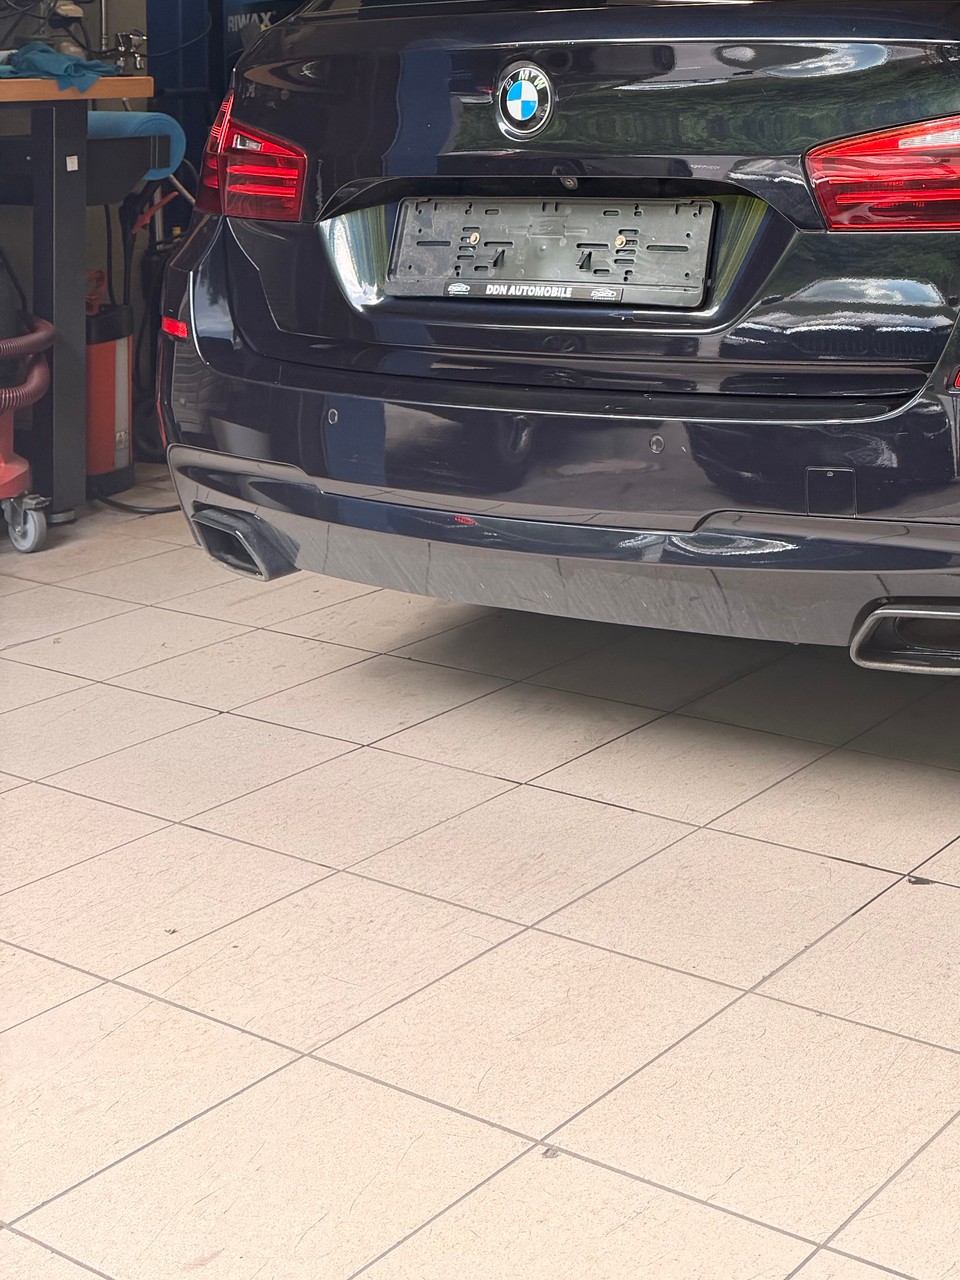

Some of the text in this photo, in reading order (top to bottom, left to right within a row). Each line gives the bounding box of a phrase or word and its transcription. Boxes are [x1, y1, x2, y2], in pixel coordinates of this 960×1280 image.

[504, 69, 546, 91] BMW
[485, 284, 508, 295] DDN
[508, 285, 572, 298] AUTOMOBILE
